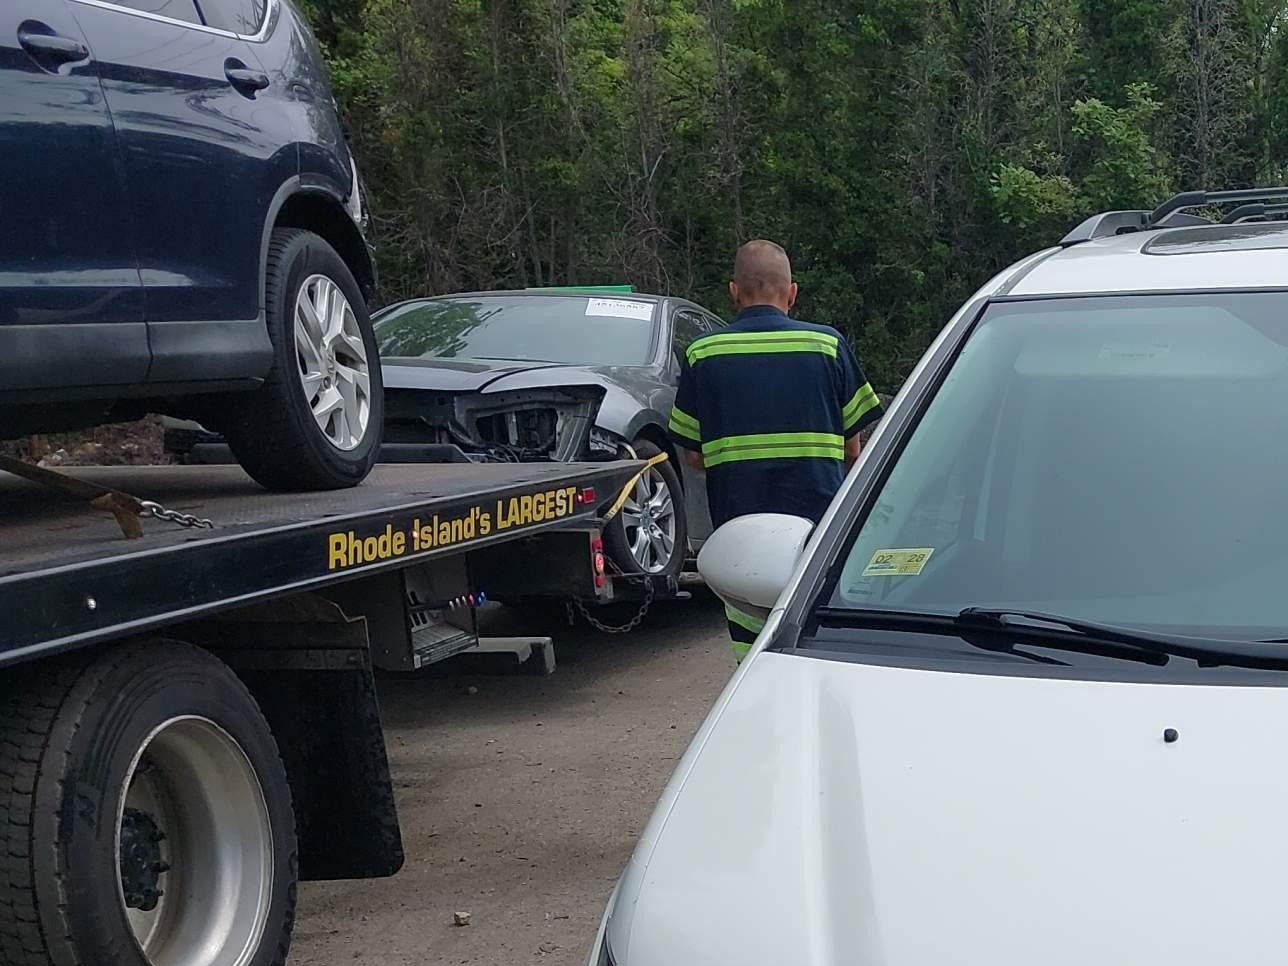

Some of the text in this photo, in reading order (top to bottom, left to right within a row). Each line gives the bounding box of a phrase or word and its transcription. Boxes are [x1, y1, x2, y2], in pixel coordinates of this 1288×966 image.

[328, 486, 577, 569] Rhode Island's LARGEST
[875, 553, 926, 564] 02 28
